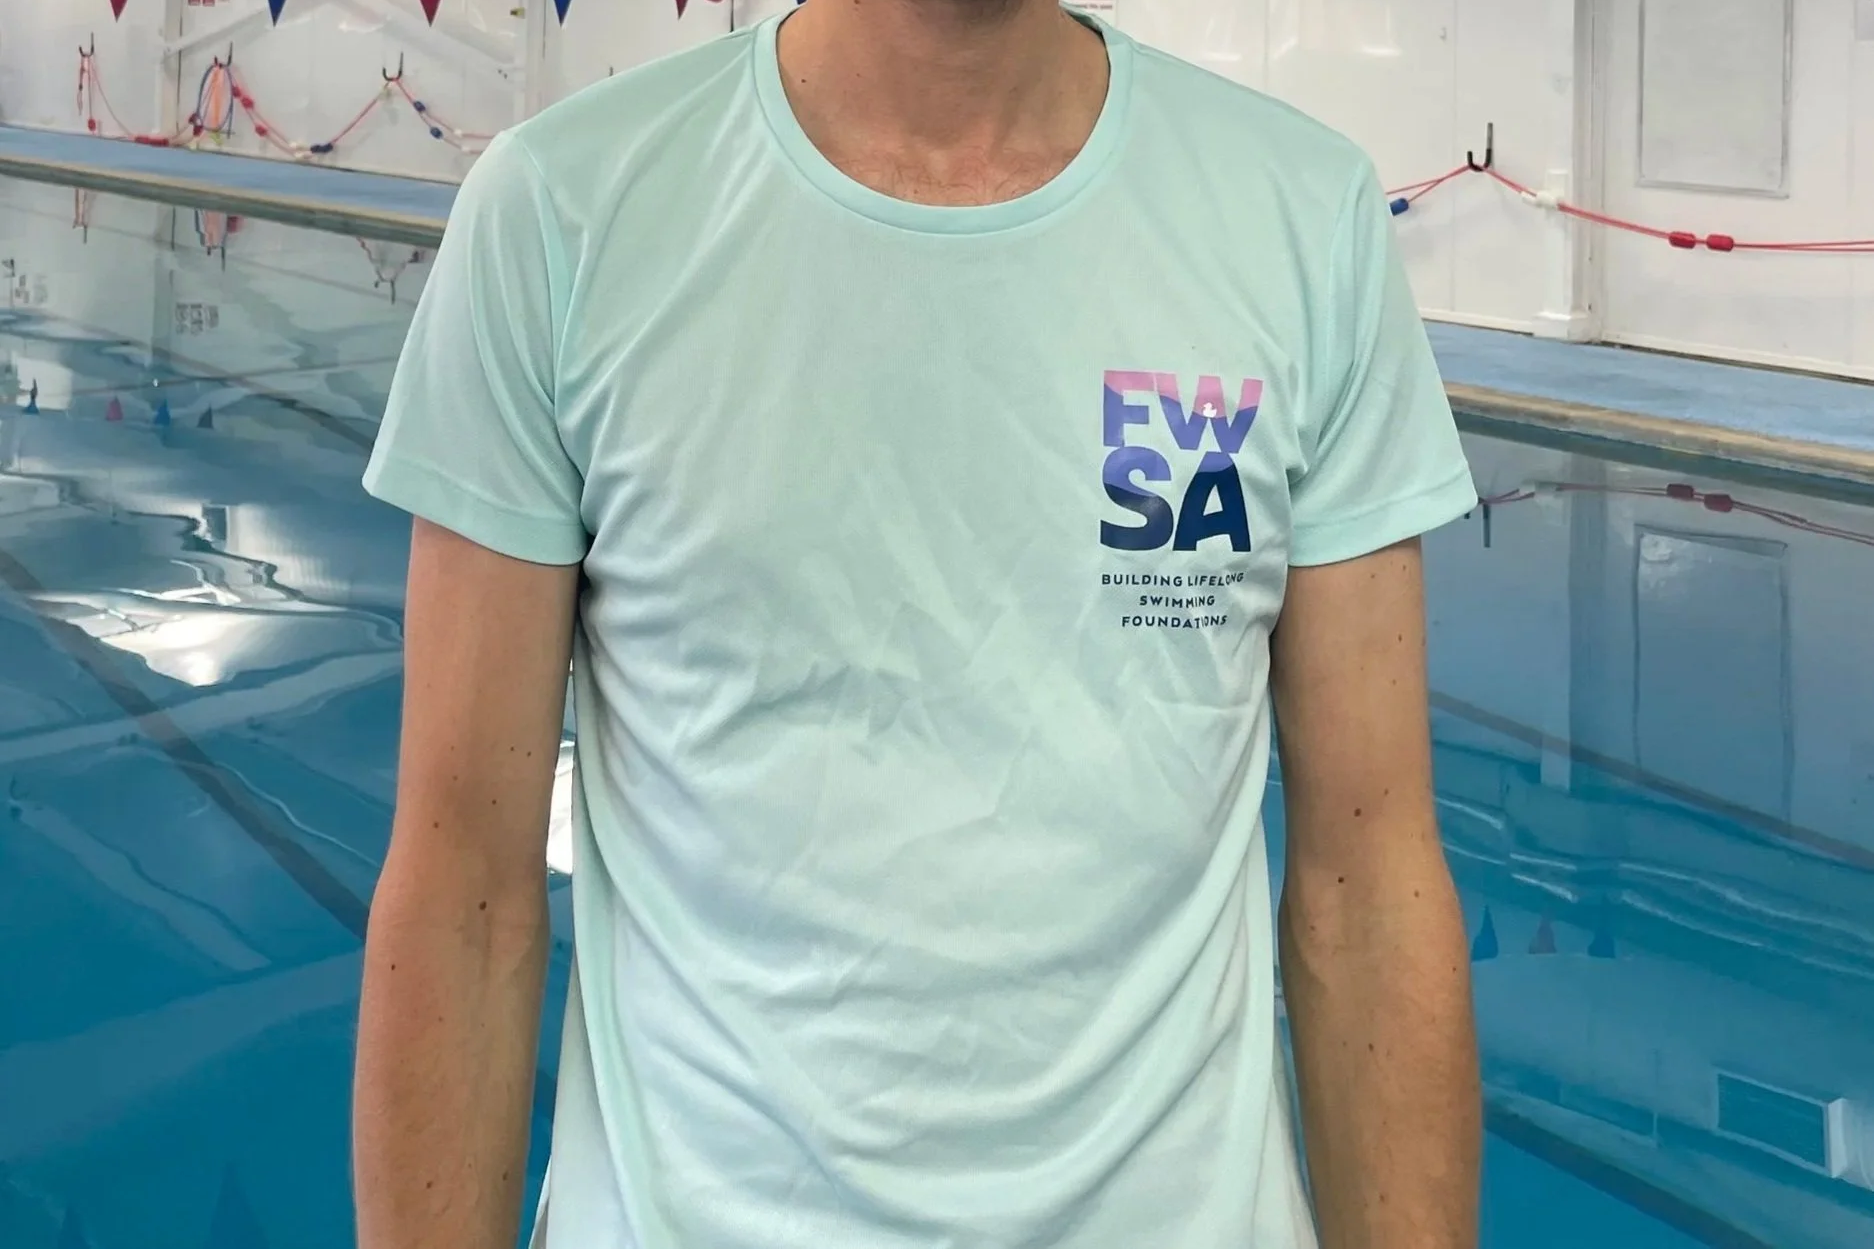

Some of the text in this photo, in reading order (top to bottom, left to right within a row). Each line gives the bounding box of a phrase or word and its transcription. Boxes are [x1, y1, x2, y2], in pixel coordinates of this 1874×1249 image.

[1103, 370, 1264, 454] FW
[1099, 446, 1252, 552] SA
[1101, 573, 1183, 587] BUILDING
[1139, 595, 1216, 608] SWIMMING
[1121, 614, 1228, 629] FOUNDATIONS
